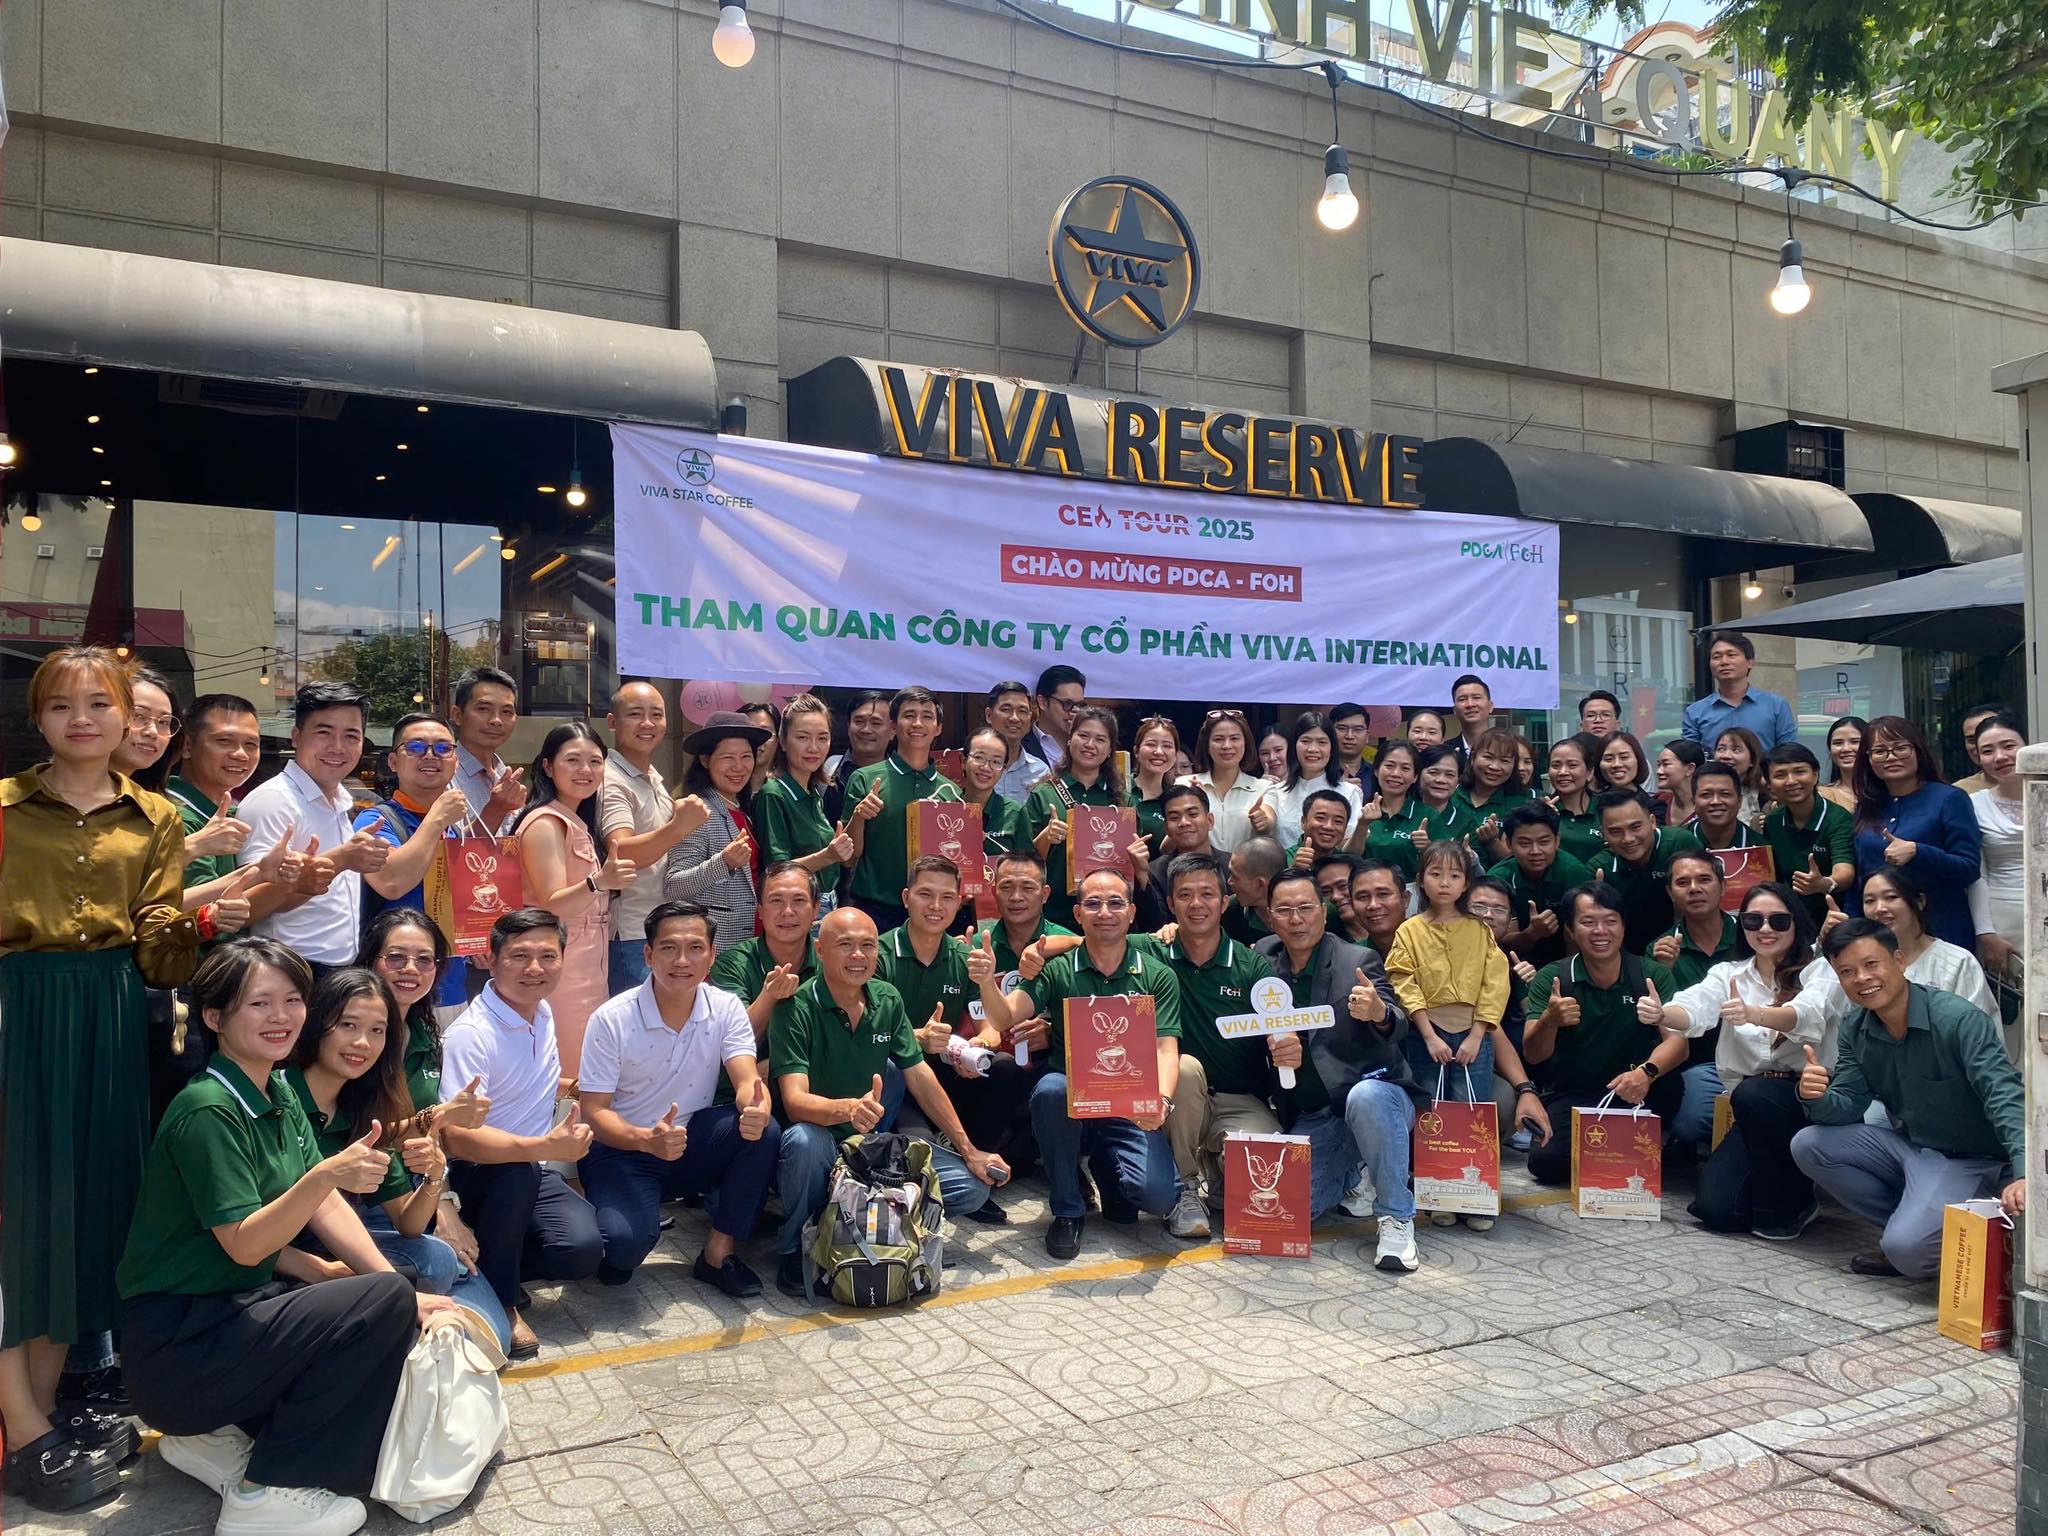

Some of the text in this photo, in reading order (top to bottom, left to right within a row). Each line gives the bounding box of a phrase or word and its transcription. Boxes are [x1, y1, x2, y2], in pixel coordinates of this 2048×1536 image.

[1086, 250, 1169, 288] VIVA
[878, 365, 1426, 506] VIVA RESERVE
[685, 463, 707, 473] VIVA
[640, 484, 753, 509] VIVA STAR COFFEE
[1118, 509, 1191, 536] TOUR
[1196, 516, 1255, 541] 2025
[1011, 552, 1083, 579] CHÀO
[1089, 556, 1161, 585] MỪNG
[1167, 567, 1230, 589] PDCA
[1249, 572, 1294, 593] FOH
[634, 592, 1548, 672] THAM QUAN CÔNG TY CỔ PHẦN VIVA INTERNATIONAL
[432, 885, 441, 924] IETNAMESE
[1223, 1010, 1331, 1034] VIVA RESERVE
[1953, 1227, 1967, 1309] VIETNAMESE COFFEE
